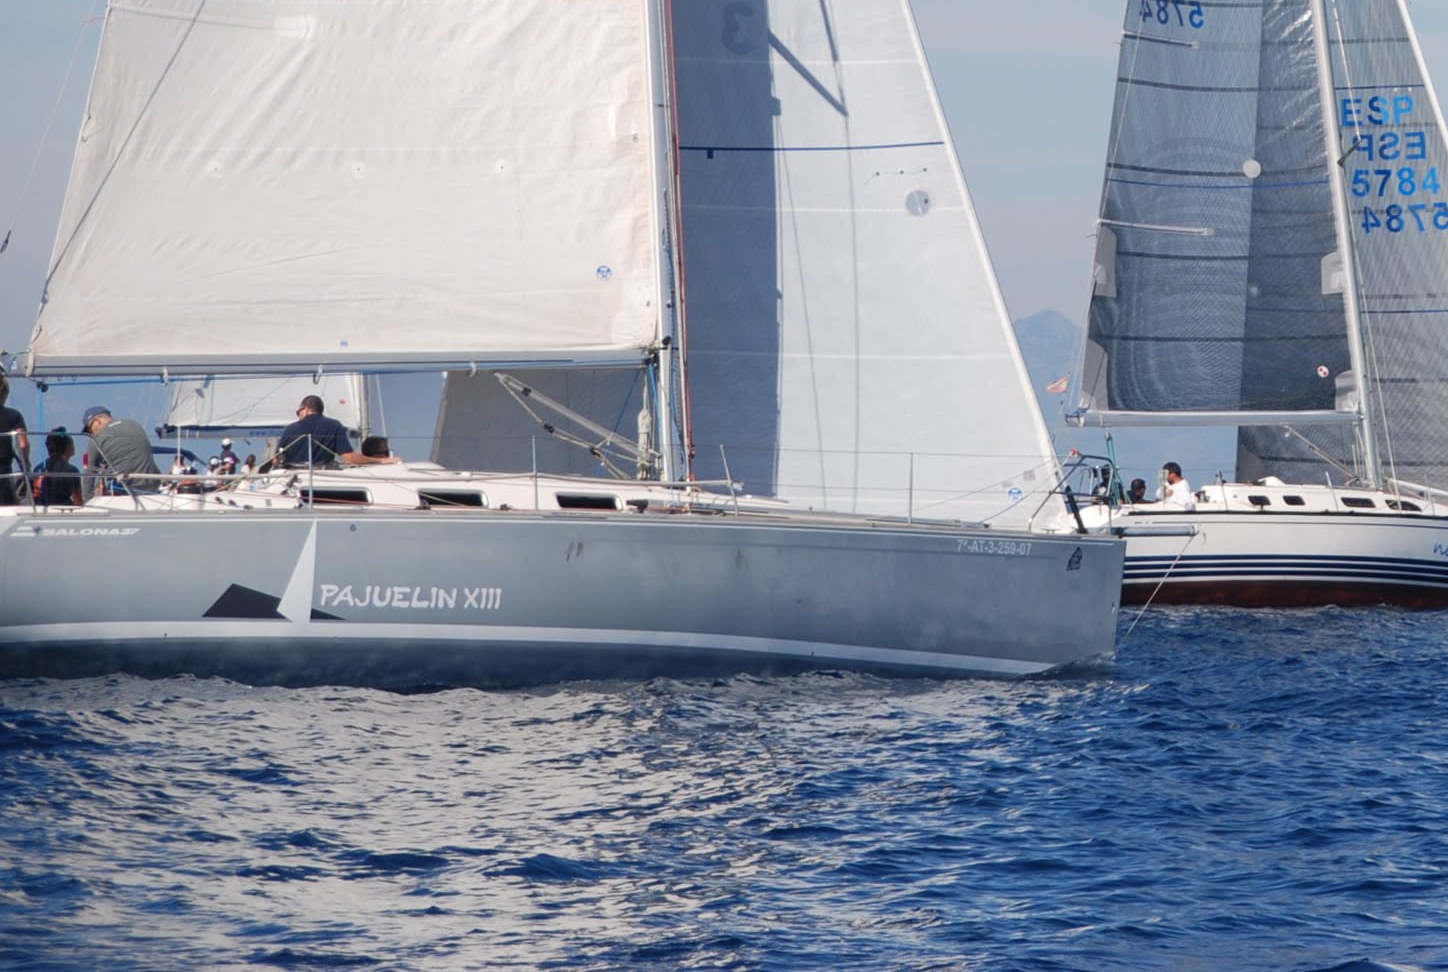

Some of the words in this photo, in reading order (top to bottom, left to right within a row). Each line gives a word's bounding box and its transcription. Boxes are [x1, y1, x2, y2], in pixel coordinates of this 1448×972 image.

[1341, 95, 1414, 127] ESP
[1351, 166, 1441, 197] 5784
[320, 584, 457, 609] PAJUELIN
[464, 587, 502, 610] XIII
